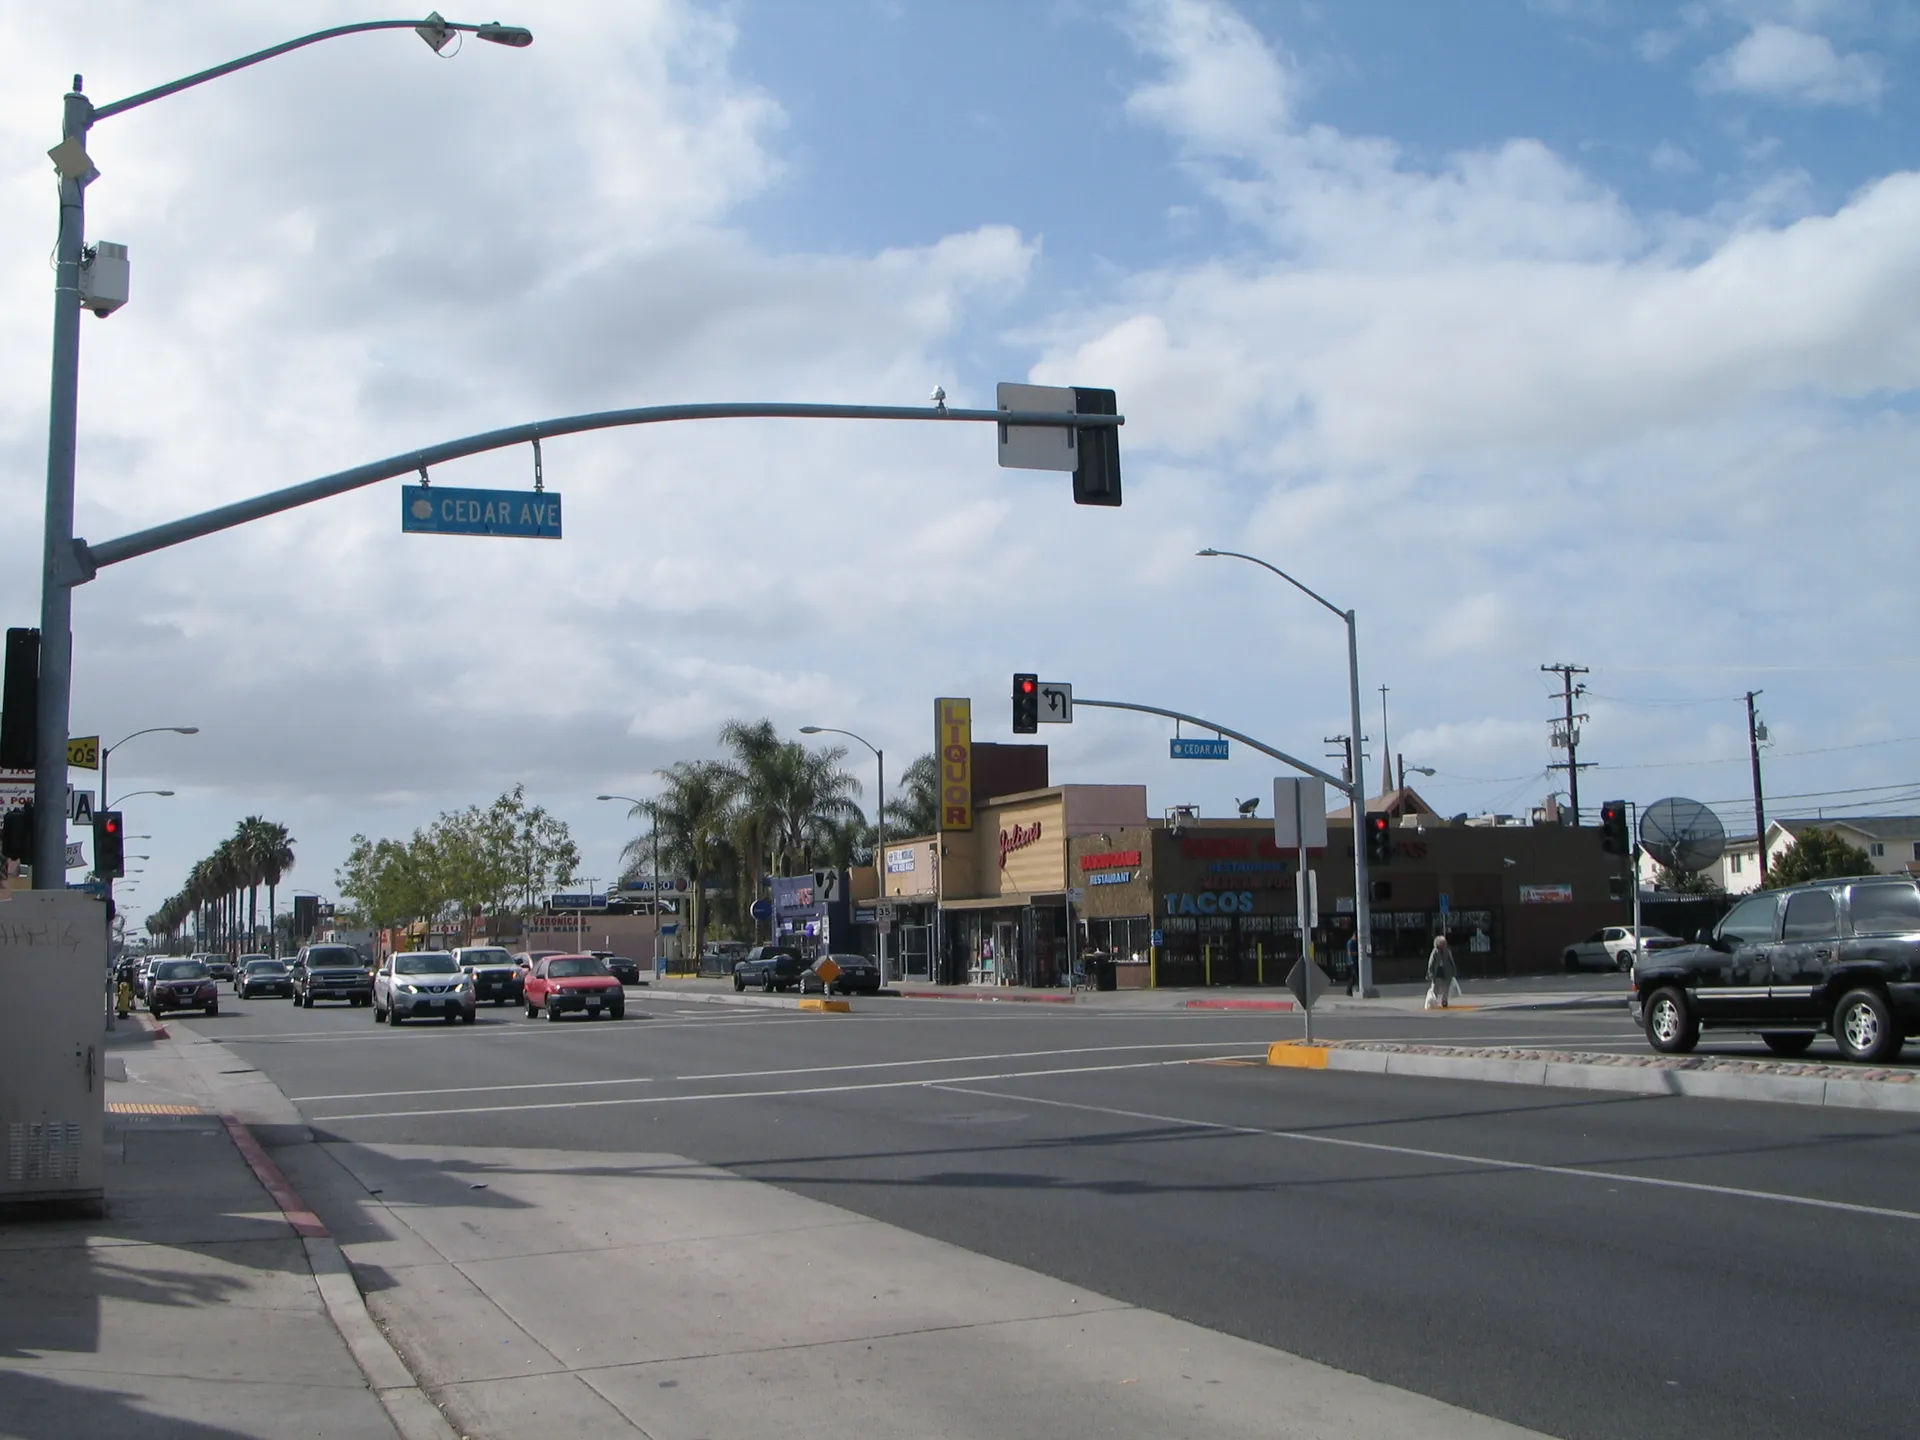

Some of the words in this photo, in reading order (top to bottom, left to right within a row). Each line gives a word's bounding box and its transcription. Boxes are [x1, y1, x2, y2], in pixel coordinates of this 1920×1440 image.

[441, 499, 511, 524] CEDAR
[519, 503, 560, 527] AVE
[1184, 744, 1211, 755] CEDAR
[1213, 745, 1228, 755] AVE
[944, 706, 968, 825] LIQUOR
[1089, 872, 1130, 886] RESTAURANT
[879, 907, 891, 916] 35
[1164, 891, 1254, 915] TACOS
